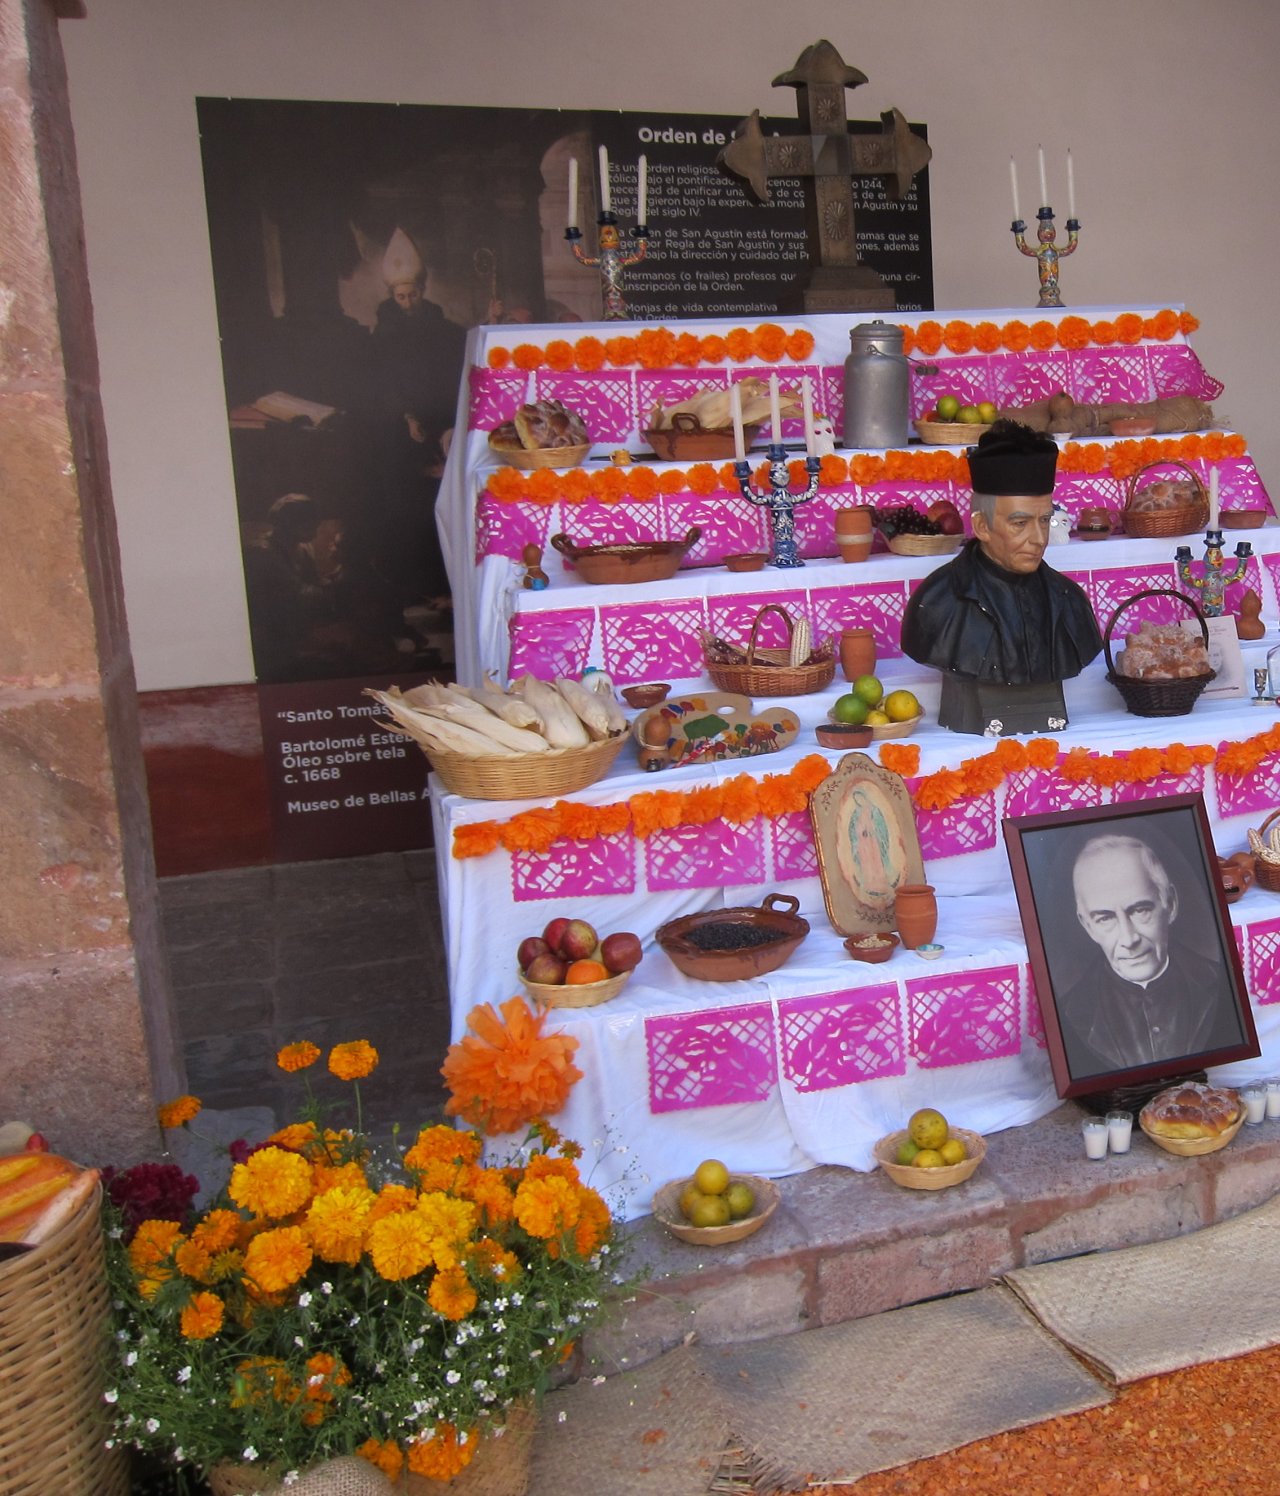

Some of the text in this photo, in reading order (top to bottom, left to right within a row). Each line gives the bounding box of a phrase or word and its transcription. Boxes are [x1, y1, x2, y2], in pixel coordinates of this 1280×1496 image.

[638, 128, 697, 143] Orden
[703, 130, 725, 144] de
[677, 163, 719, 175] religiosa
[665, 176, 675, 184] el
[861, 181, 884, 190] 1244,
[666, 187, 874, 200] de unificar una de de
[683, 198, 705, 207] bajo
[863, 200, 897, 211] Agustín
[662, 208, 686, 218] siglo
[690, 208, 701, 217] IV.
[665, 229, 678, 238] de
[682, 230, 700, 238] San
[705, 230, 741, 240] Agustín
[747, 231, 767, 239] está
[856, 232, 885, 240] ramas
[888, 233, 905, 242] que
[666, 240, 694, 249] Regla
[698, 240, 711, 249] de
[715, 240, 733, 249] San
[737, 241, 775, 250] Agustín
[884, 242, 919, 251] además
[649, 251, 797, 260] bajo la dirección cuidado del
[624, 272, 920, 282] Hermanos (o frailes) profesos cir-
[684, 282, 745, 291] de la Orden.
[625, 303, 778, 313] Monjas de vida contemplativa
[278, 703, 389, 723] “Santo Tomás
[281, 734, 365, 754] Bartolomé
[283, 747, 406, 768] Óleo sobre tela
[285, 768, 341, 783] c. 1668
[288, 799, 340, 814] Museo
[345, 795, 364, 807] de
[369, 790, 416, 805] Bellas
